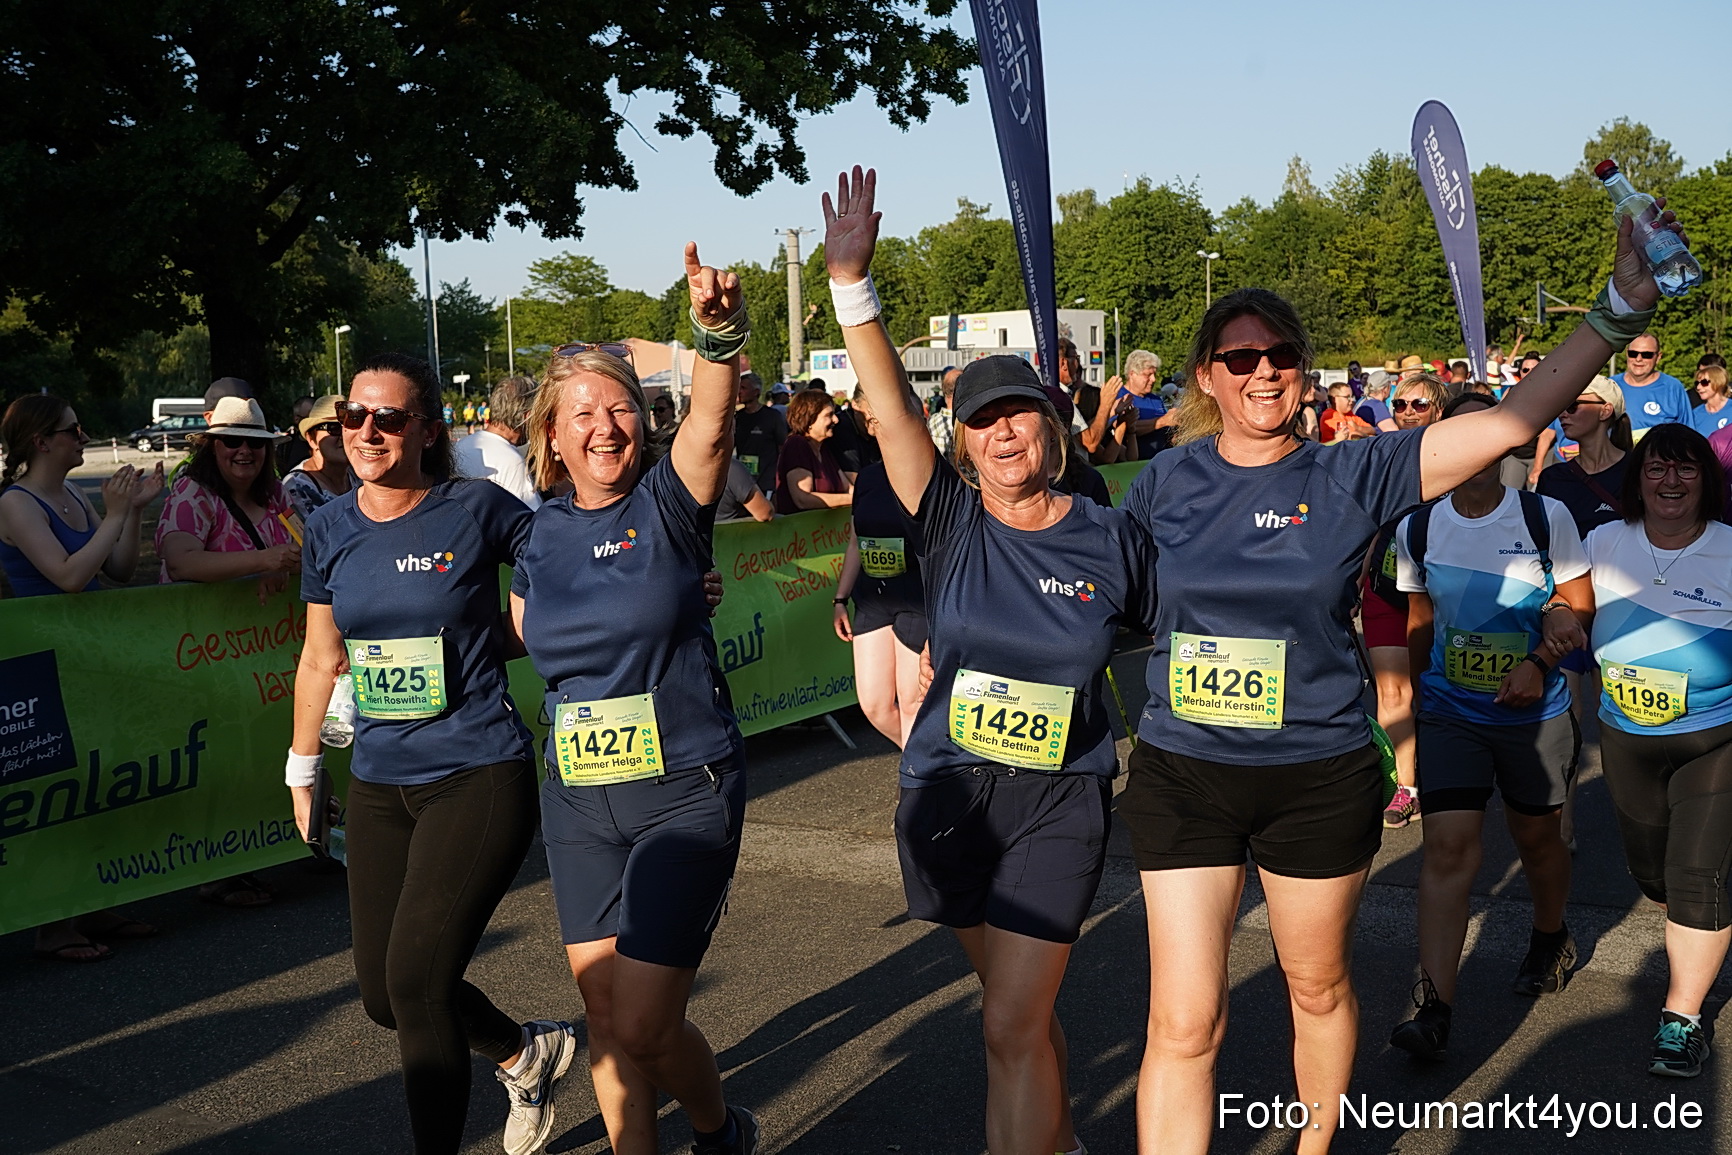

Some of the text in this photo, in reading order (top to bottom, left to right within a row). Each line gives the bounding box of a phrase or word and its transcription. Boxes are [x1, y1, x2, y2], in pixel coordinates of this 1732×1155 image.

[1655, 237, 1681, 253] STILL
[1254, 509, 1291, 528] vhs
[593, 540, 622, 559] vhs
[733, 531, 809, 581] Gesunde
[865, 551, 896, 565] 1669
[396, 554, 432, 573] vhs
[775, 568, 832, 604] laufen
[1039, 577, 1075, 597] vhs
[177, 602, 307, 671] Gesunde
[1194, 652, 1230, 660] Firmenlauf
[1458, 650, 1514, 674] 1212
[355, 674, 366, 702] RUN
[363, 666, 427, 693] 1425
[428, 669, 442, 706] 2022
[1175, 666, 1183, 707] WALK
[1186, 665, 1263, 698] 1426
[384, 695, 427, 704] Roswitha
[983, 691, 1021, 702] Firmenlauf
[1182, 695, 1265, 711] Merbald Kerstin
[1266, 676, 1278, 716] 2022
[1615, 683, 1669, 711] 1198
[575, 715, 604, 725] Firmenlauf
[956, 703, 967, 739] WALK
[971, 704, 1049, 741] 1428
[1643, 709, 1665, 719] Petra
[570, 726, 637, 758] 1427
[642, 728, 657, 765] 2022
[971, 732, 1040, 753] Stich Bettina
[1048, 721, 1063, 758] 2022
[560, 736, 572, 775] WALK
[573, 756, 642, 770] Sommer Helga
